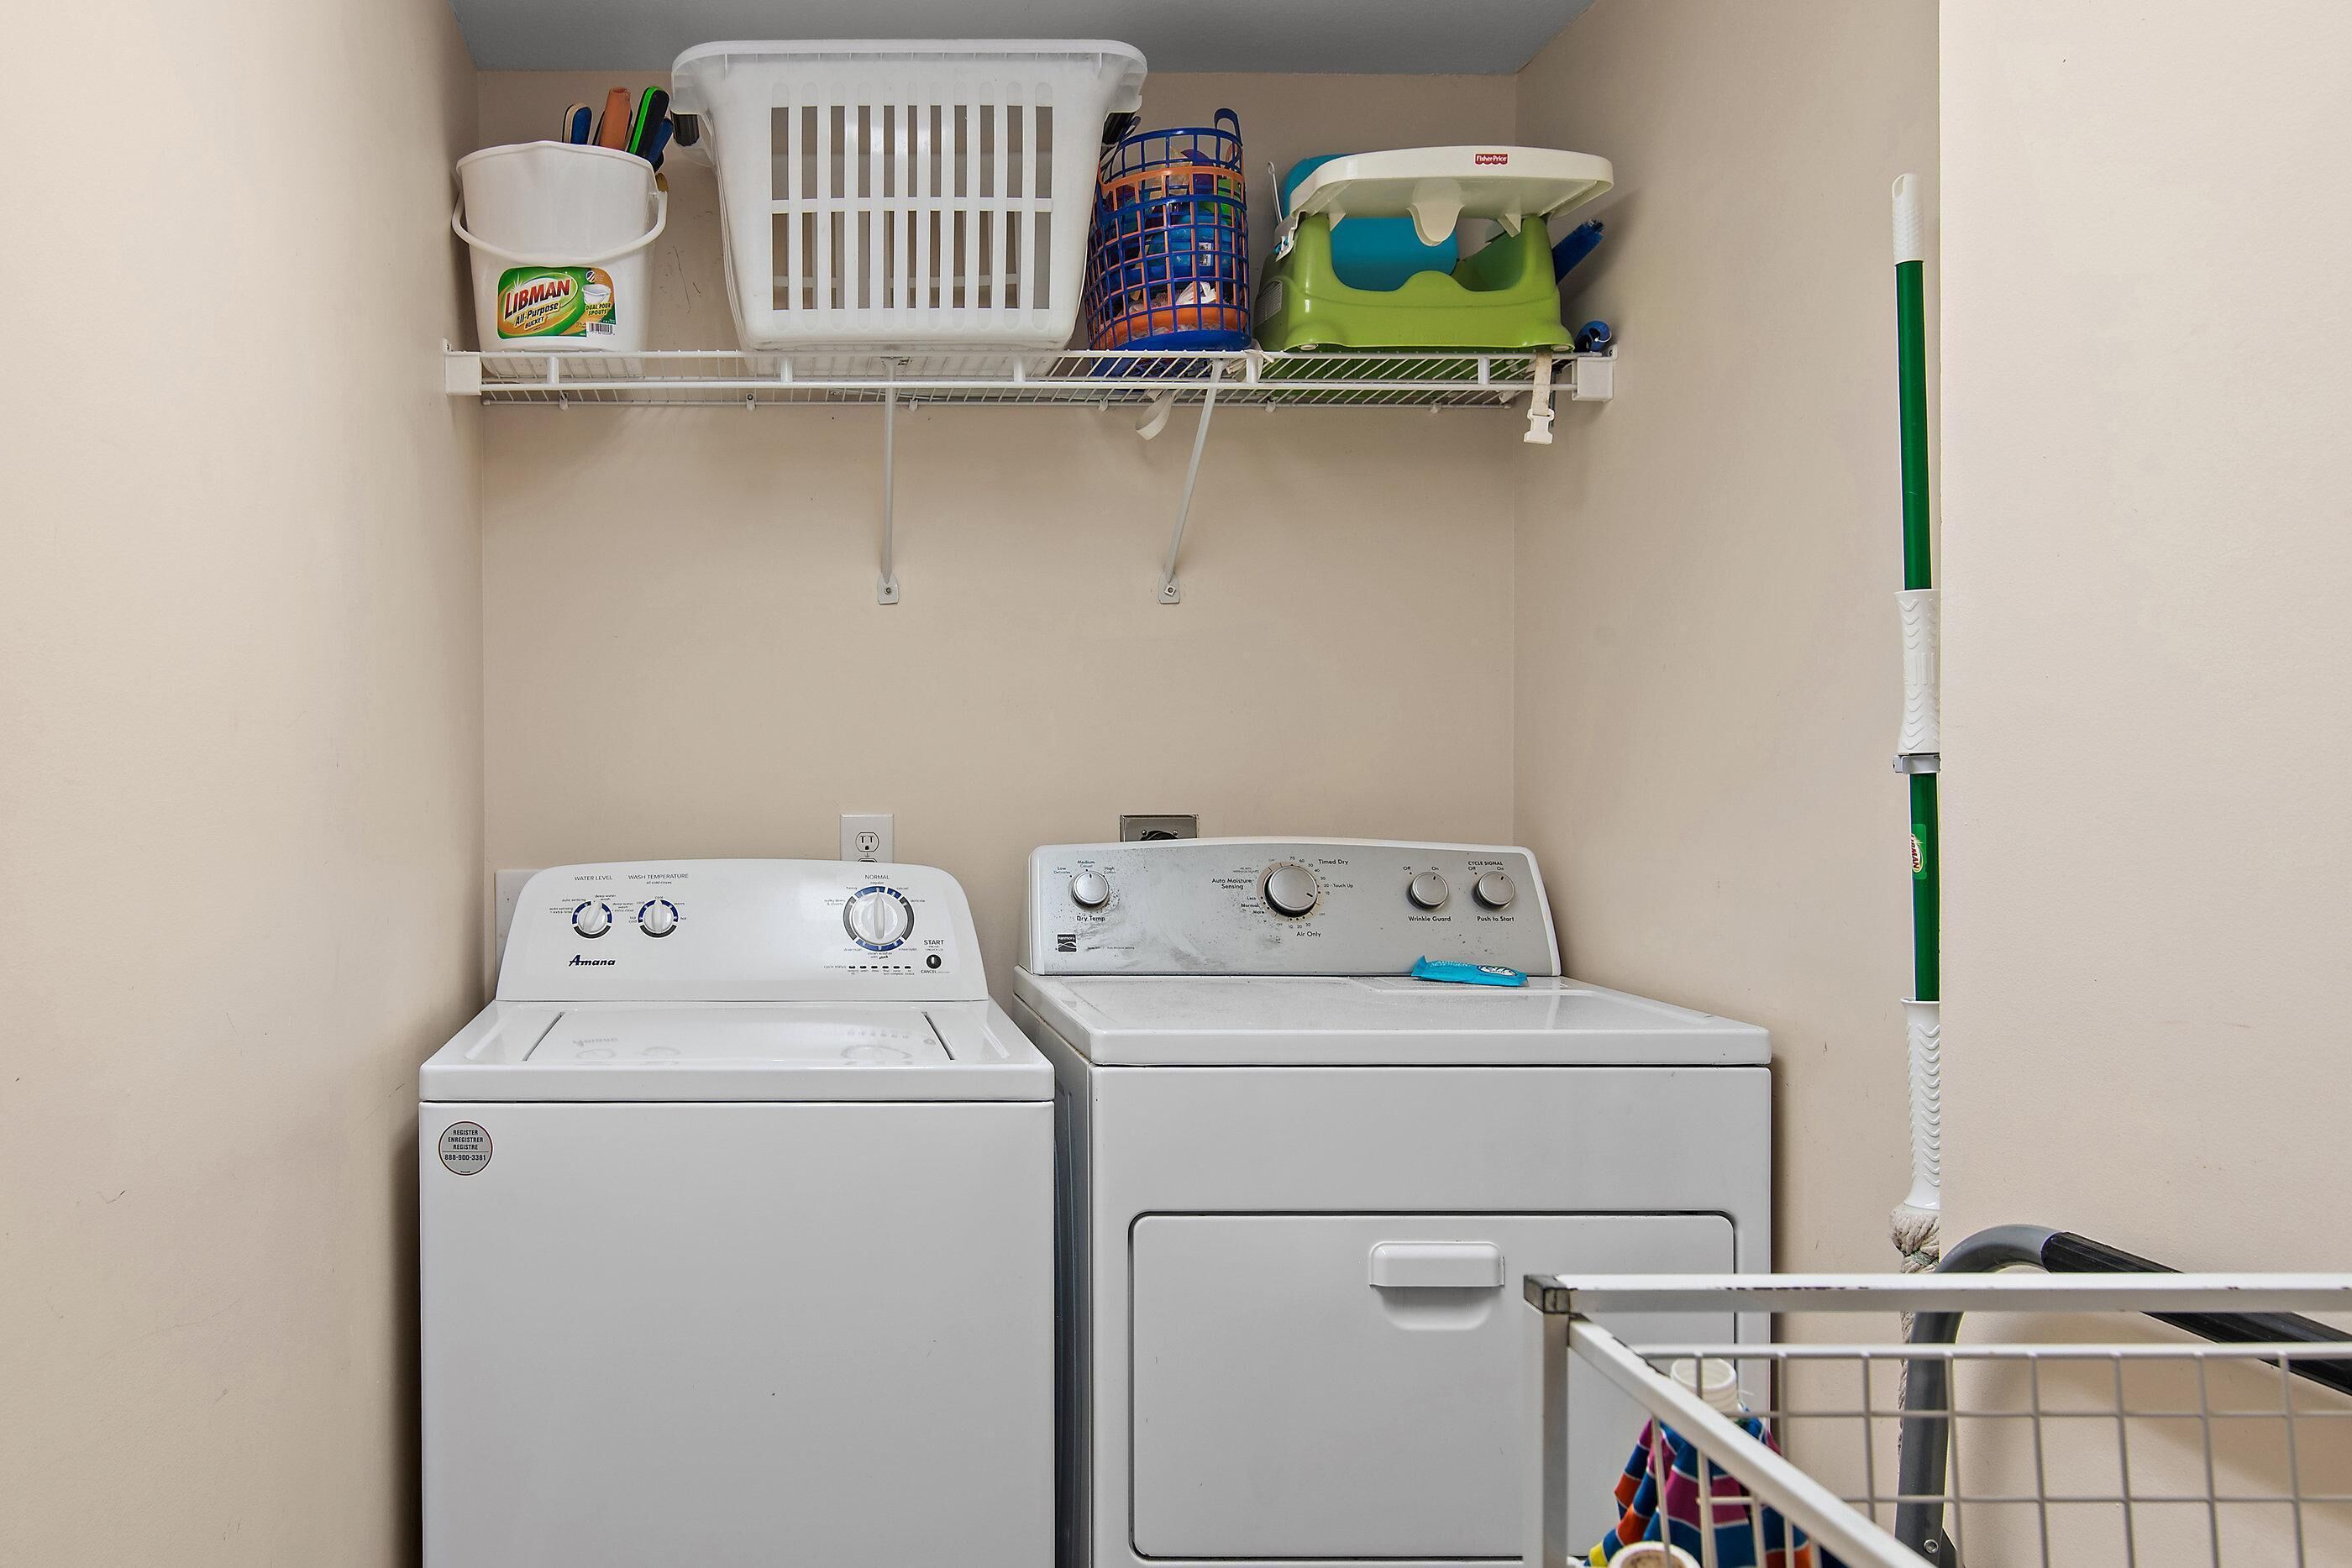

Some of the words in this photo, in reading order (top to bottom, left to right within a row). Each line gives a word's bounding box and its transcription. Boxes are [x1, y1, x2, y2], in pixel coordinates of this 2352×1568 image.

[505, 280, 570, 319] LIBMAN
[515, 302, 559, 326] All-Purpose
[525, 317, 544, 328] BUCKET
[569, 954, 615, 966] Amana
